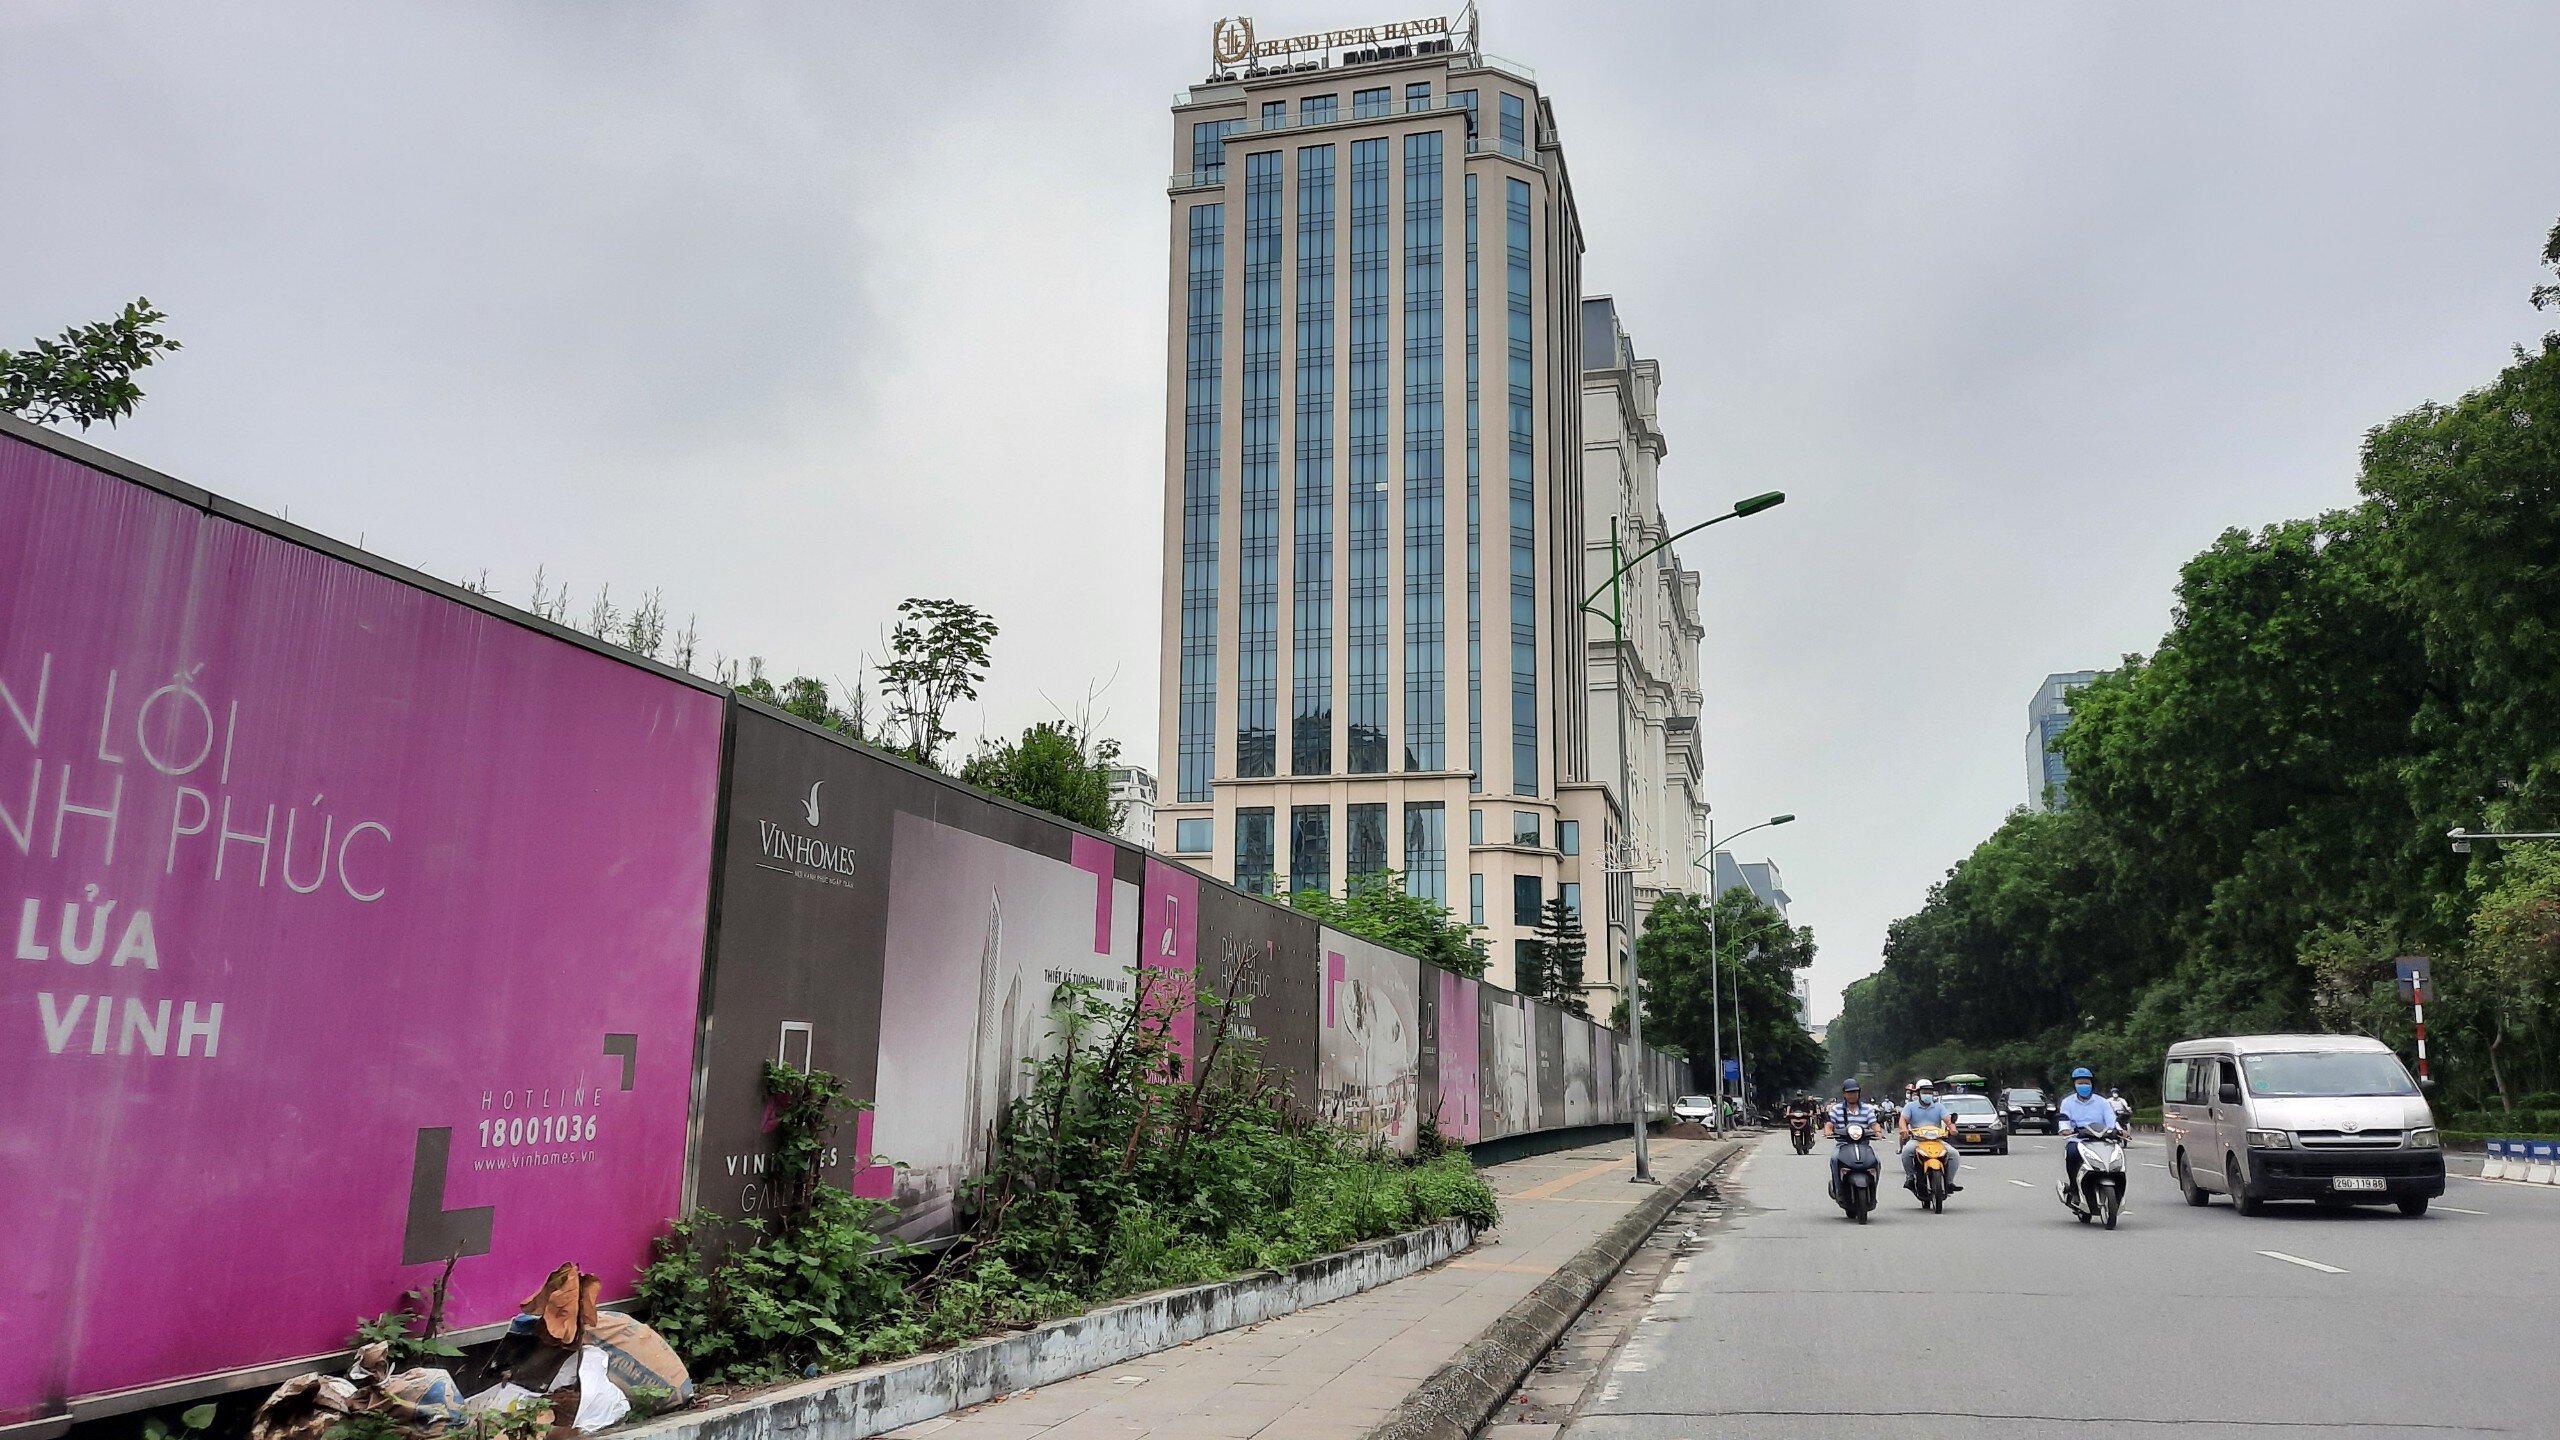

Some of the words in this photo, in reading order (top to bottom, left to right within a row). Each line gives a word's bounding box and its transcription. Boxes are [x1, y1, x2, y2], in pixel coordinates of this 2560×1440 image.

[1256, 34, 1319, 56] GRAND
[1325, 27, 1377, 47] VISTA
[1385, 16, 1447, 40] HANOI
[98, 662, 238, 784] LỐI
[165, 785, 391, 902] PHÚC
[759, 819, 855, 876] VINHOMES
[15, 883, 159, 970] LỬA
[1044, 965, 1061, 984] THIẾT
[1250, 968, 1271, 998] PHÚC
[37, 991, 224, 1057] VINH
[481, 1088, 602, 1110] HOTLINE
[479, 1114, 597, 1148] 18001036
[473, 1150, 595, 1171] www.vinhomes.vn
